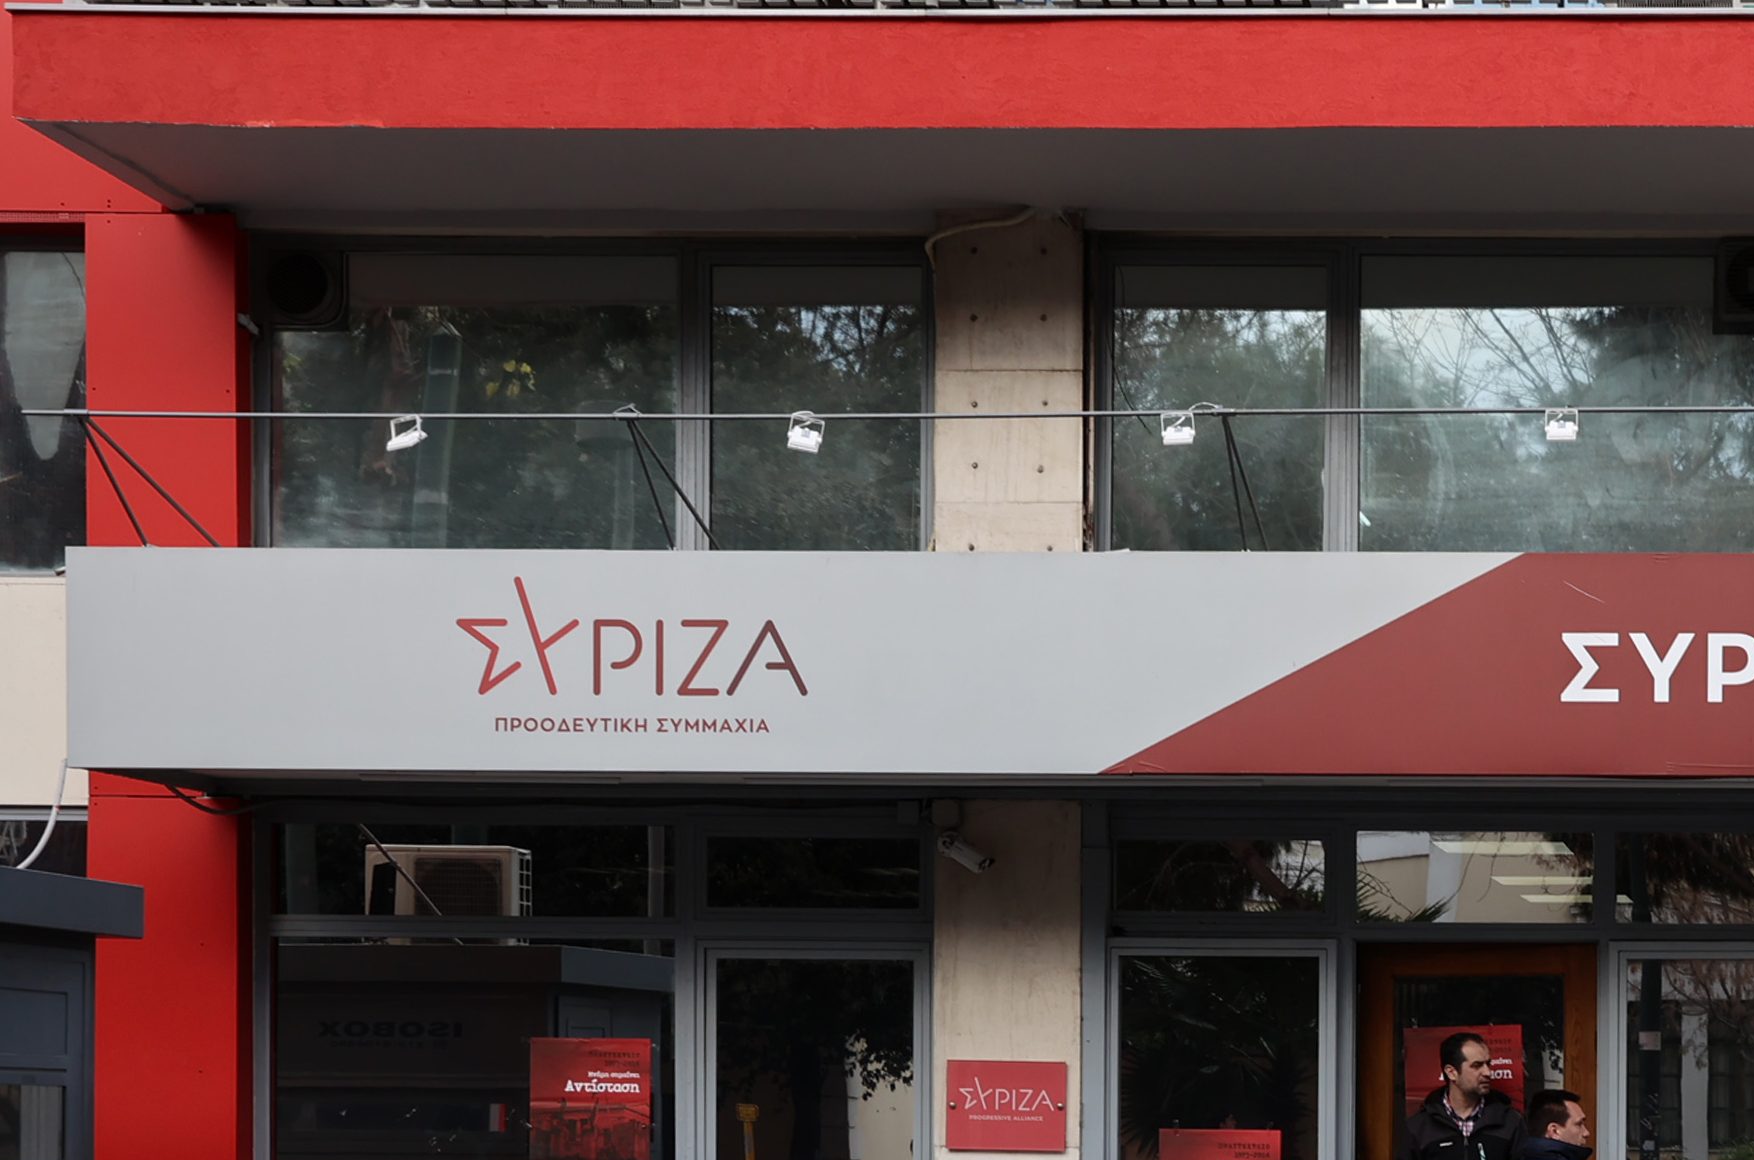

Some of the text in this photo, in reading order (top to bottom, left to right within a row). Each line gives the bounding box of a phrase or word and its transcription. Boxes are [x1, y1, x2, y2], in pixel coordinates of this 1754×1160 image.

[456, 576, 808, 696] ΣΥΡΙΖΑ
[495, 717, 770, 733] ΠΡΟΟΔΕΥΤΙΚΗ ΣΥΜΜΑΧΙΑ
[564, 1078, 640, 1093] Αντίσταση
[958, 1076, 1055, 1112] ΣΥΡΙΖΑ
